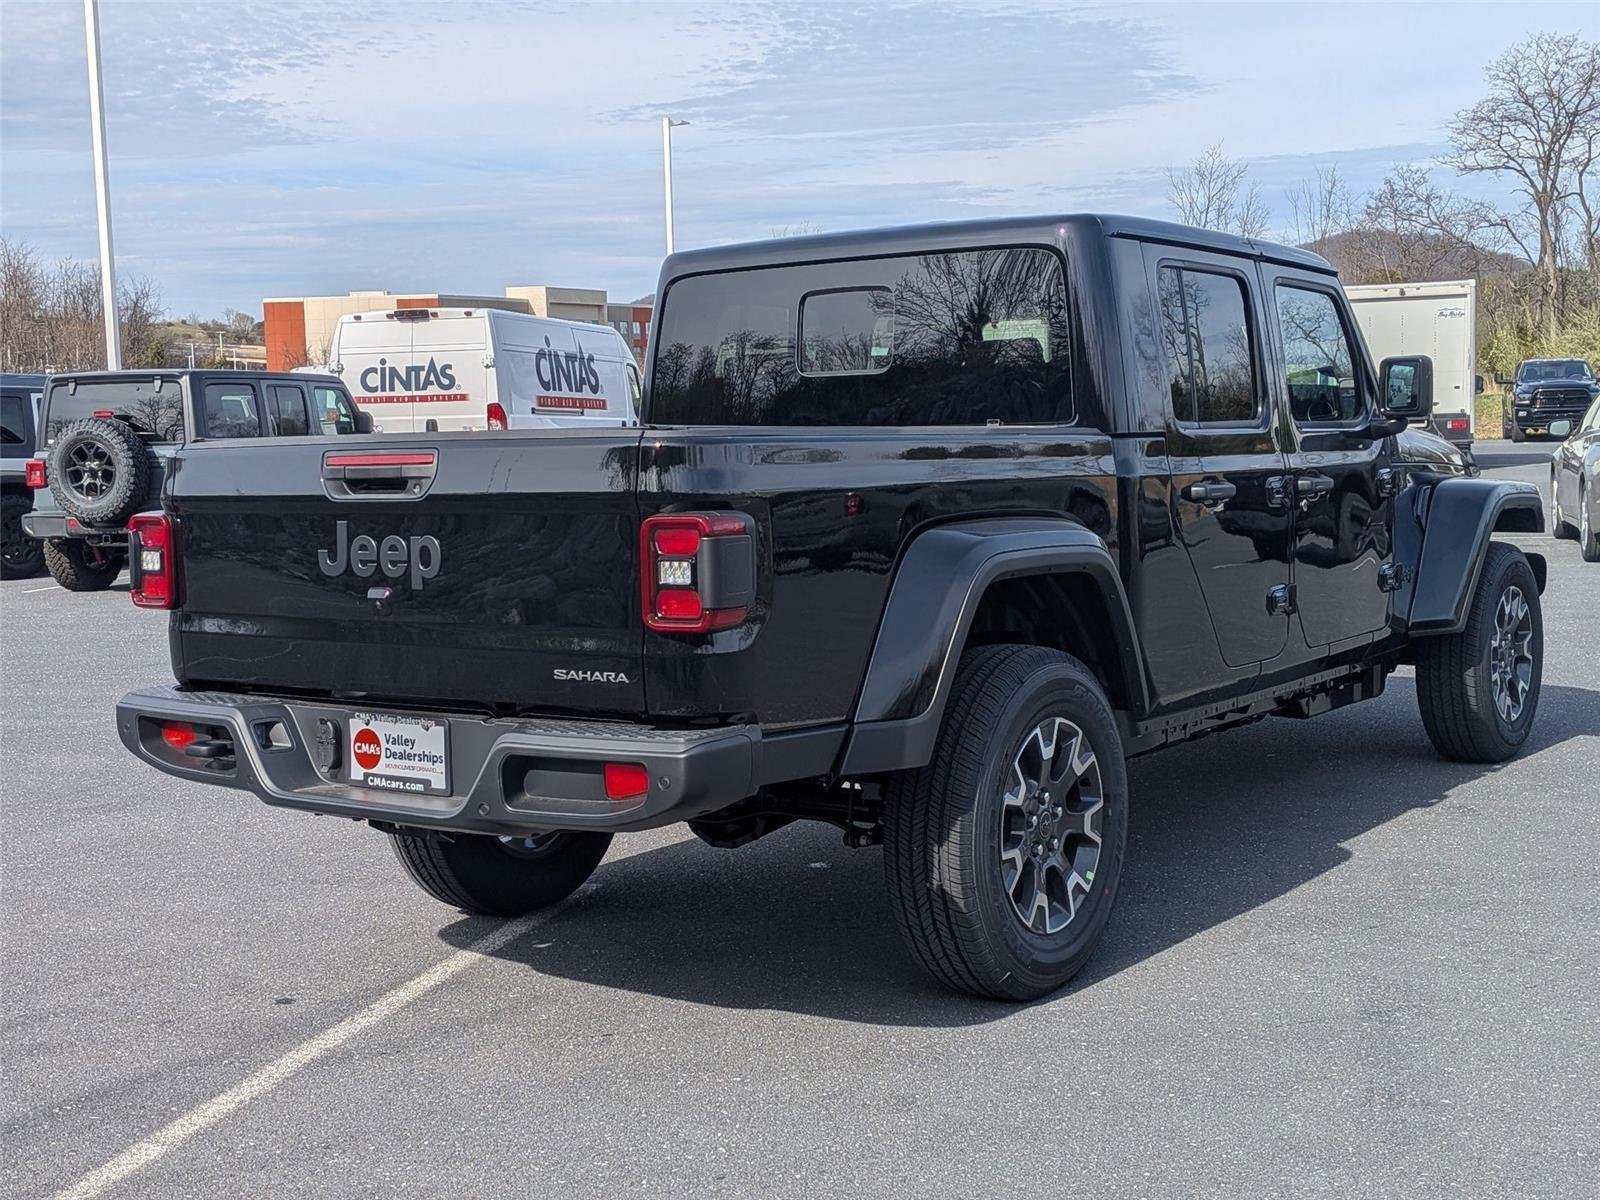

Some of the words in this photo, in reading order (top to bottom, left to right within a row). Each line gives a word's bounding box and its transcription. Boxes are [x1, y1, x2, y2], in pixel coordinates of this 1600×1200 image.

[317, 520, 442, 590] Jeep
[553, 669, 629, 683] SAHARA
[354, 742, 381, 756] CMA's
[384, 733, 416, 750] Valley
[384, 747, 444, 766] Dealerships
[367, 776, 425, 792] CMAcars.com
